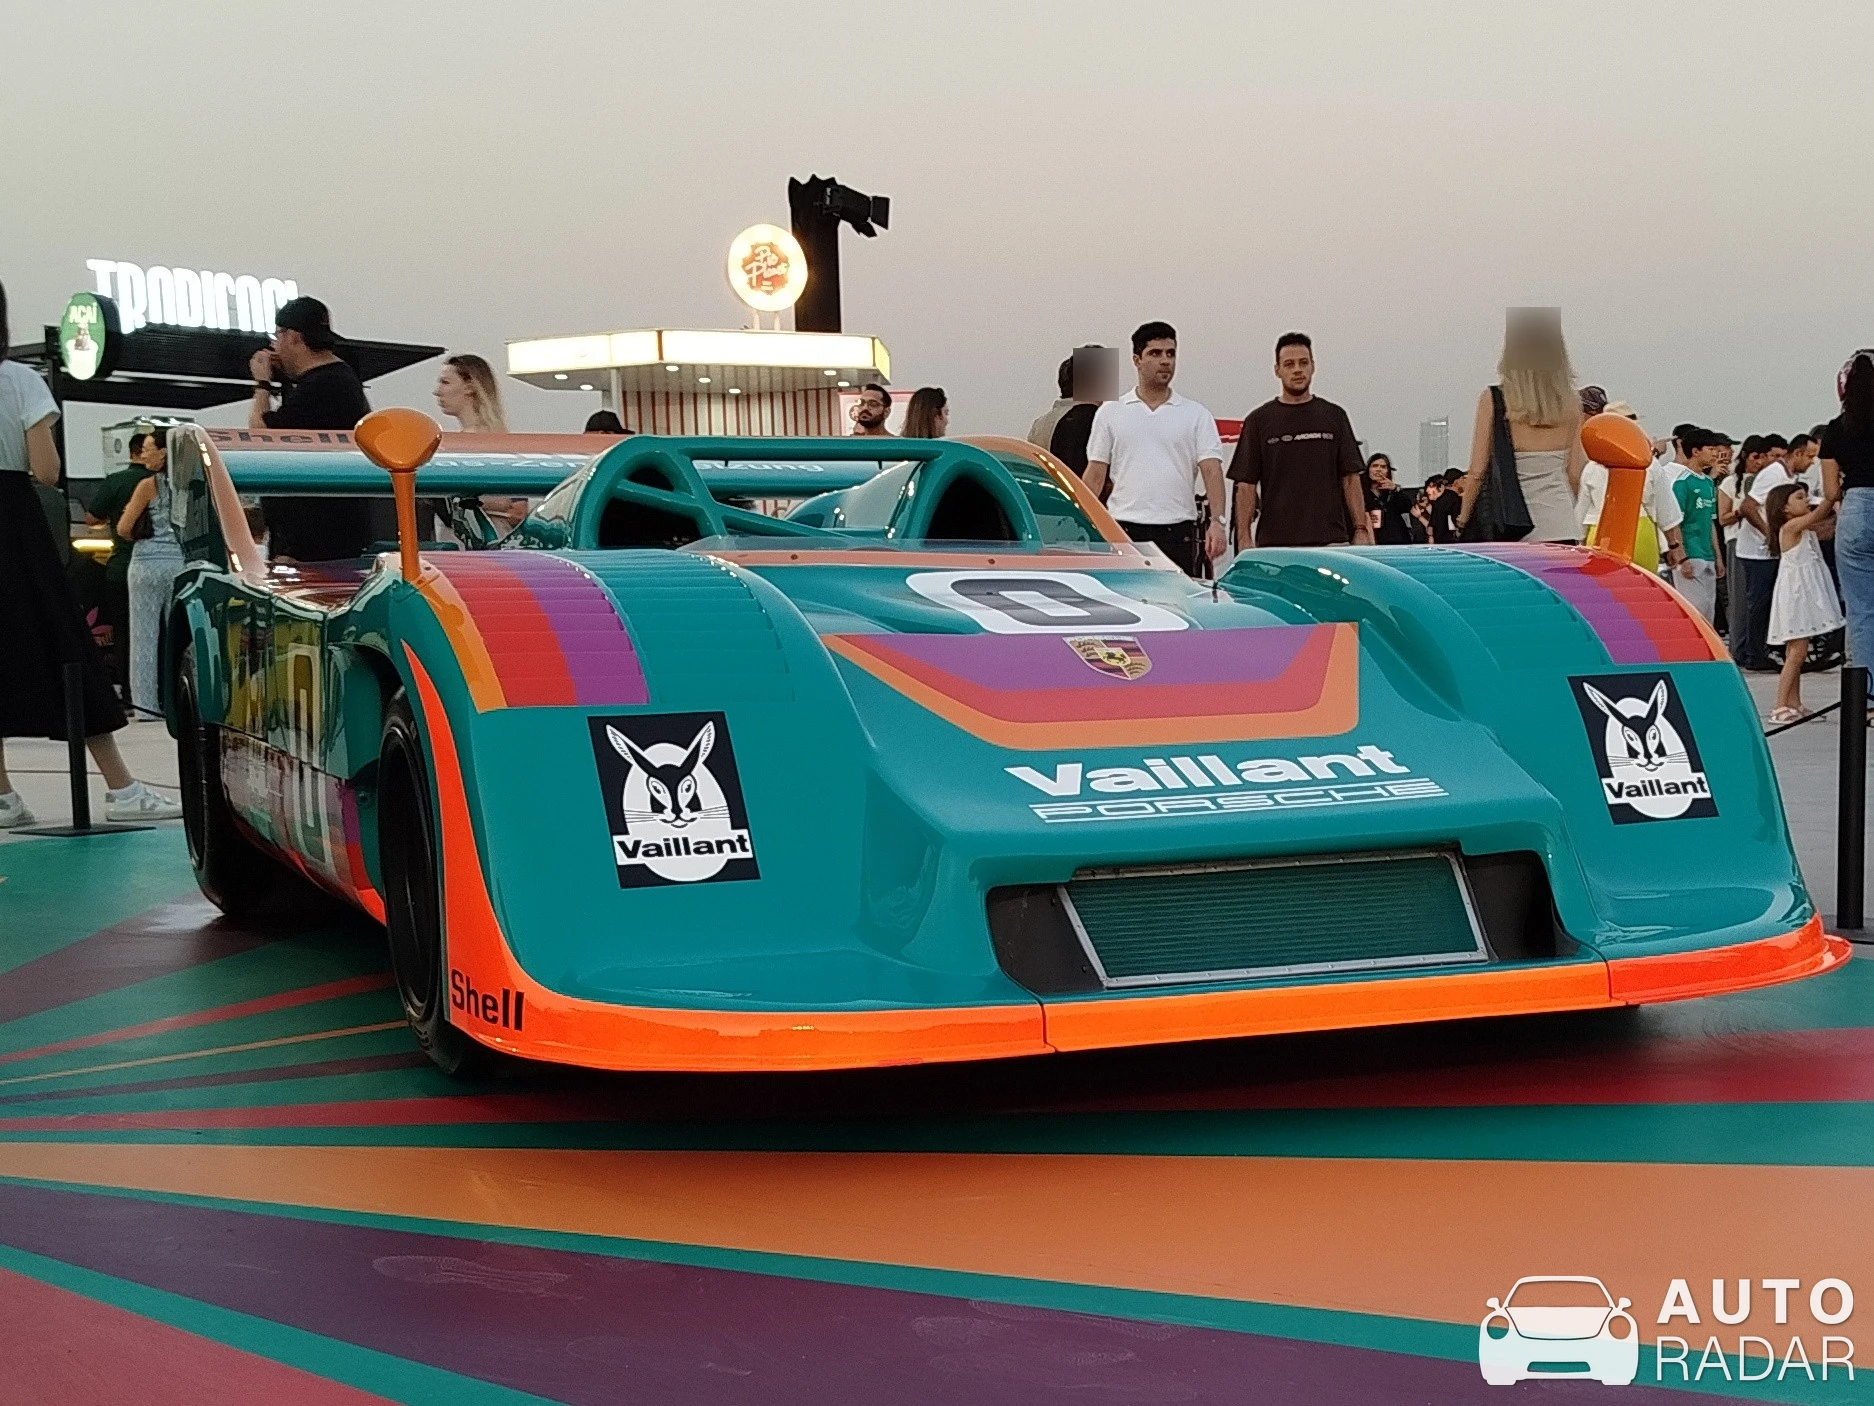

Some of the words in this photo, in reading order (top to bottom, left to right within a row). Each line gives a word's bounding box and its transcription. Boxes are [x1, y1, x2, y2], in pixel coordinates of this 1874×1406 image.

[1004, 745, 1411, 797] Vaillant
[1605, 776, 1708, 799] Vaillant
[1032, 781, 1446, 820] PORSCHE
[616, 834, 750, 859] Vaillant
[451, 968, 525, 1032] Shell
